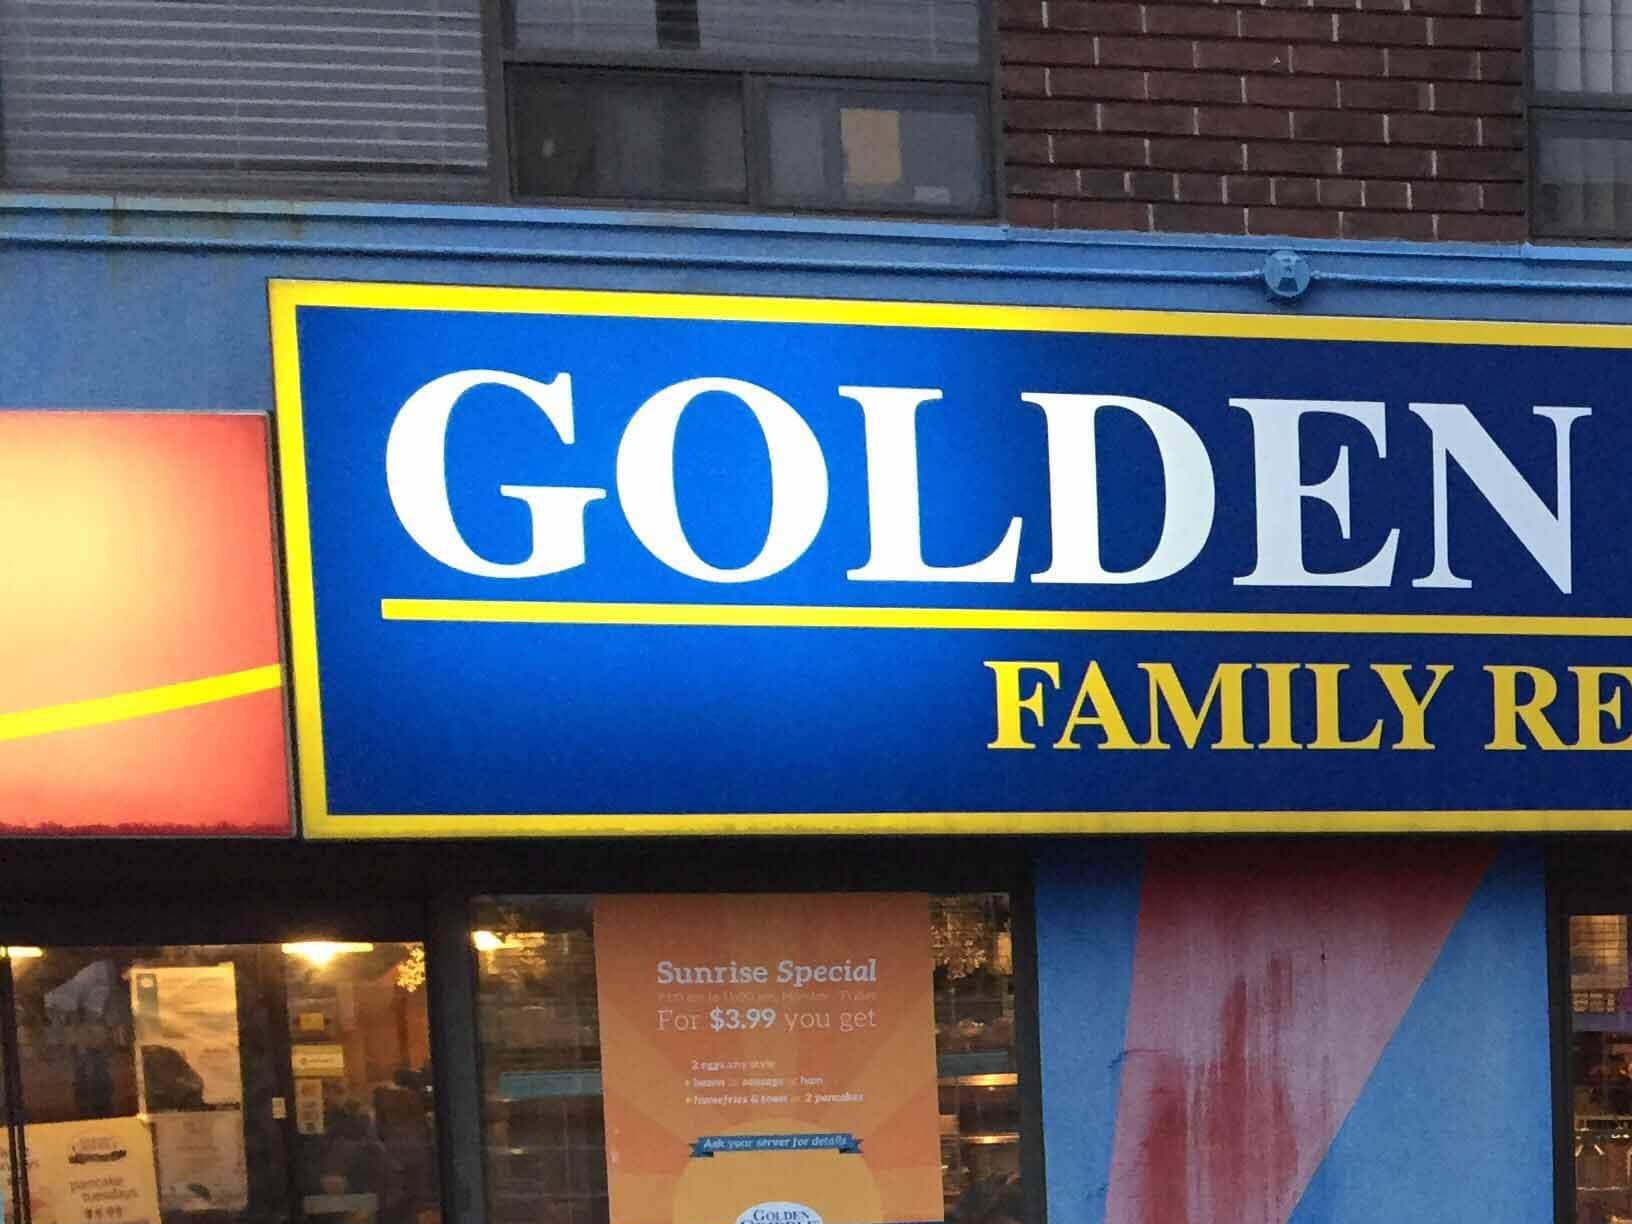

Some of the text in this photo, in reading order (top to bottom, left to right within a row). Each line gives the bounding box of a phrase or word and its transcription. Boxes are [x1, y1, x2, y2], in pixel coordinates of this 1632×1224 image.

[385, 368, 1592, 595] GOLDEN
[986, 660, 1455, 751] FAMILY
[656, 958, 878, 988] Sunrise Special
[656, 1005, 878, 1032] For $3.99 you get
[703, 1137, 726, 1148] Ask
[756, 1136, 790, 1147] server
[753, 1208, 809, 1221] GOLDEN
